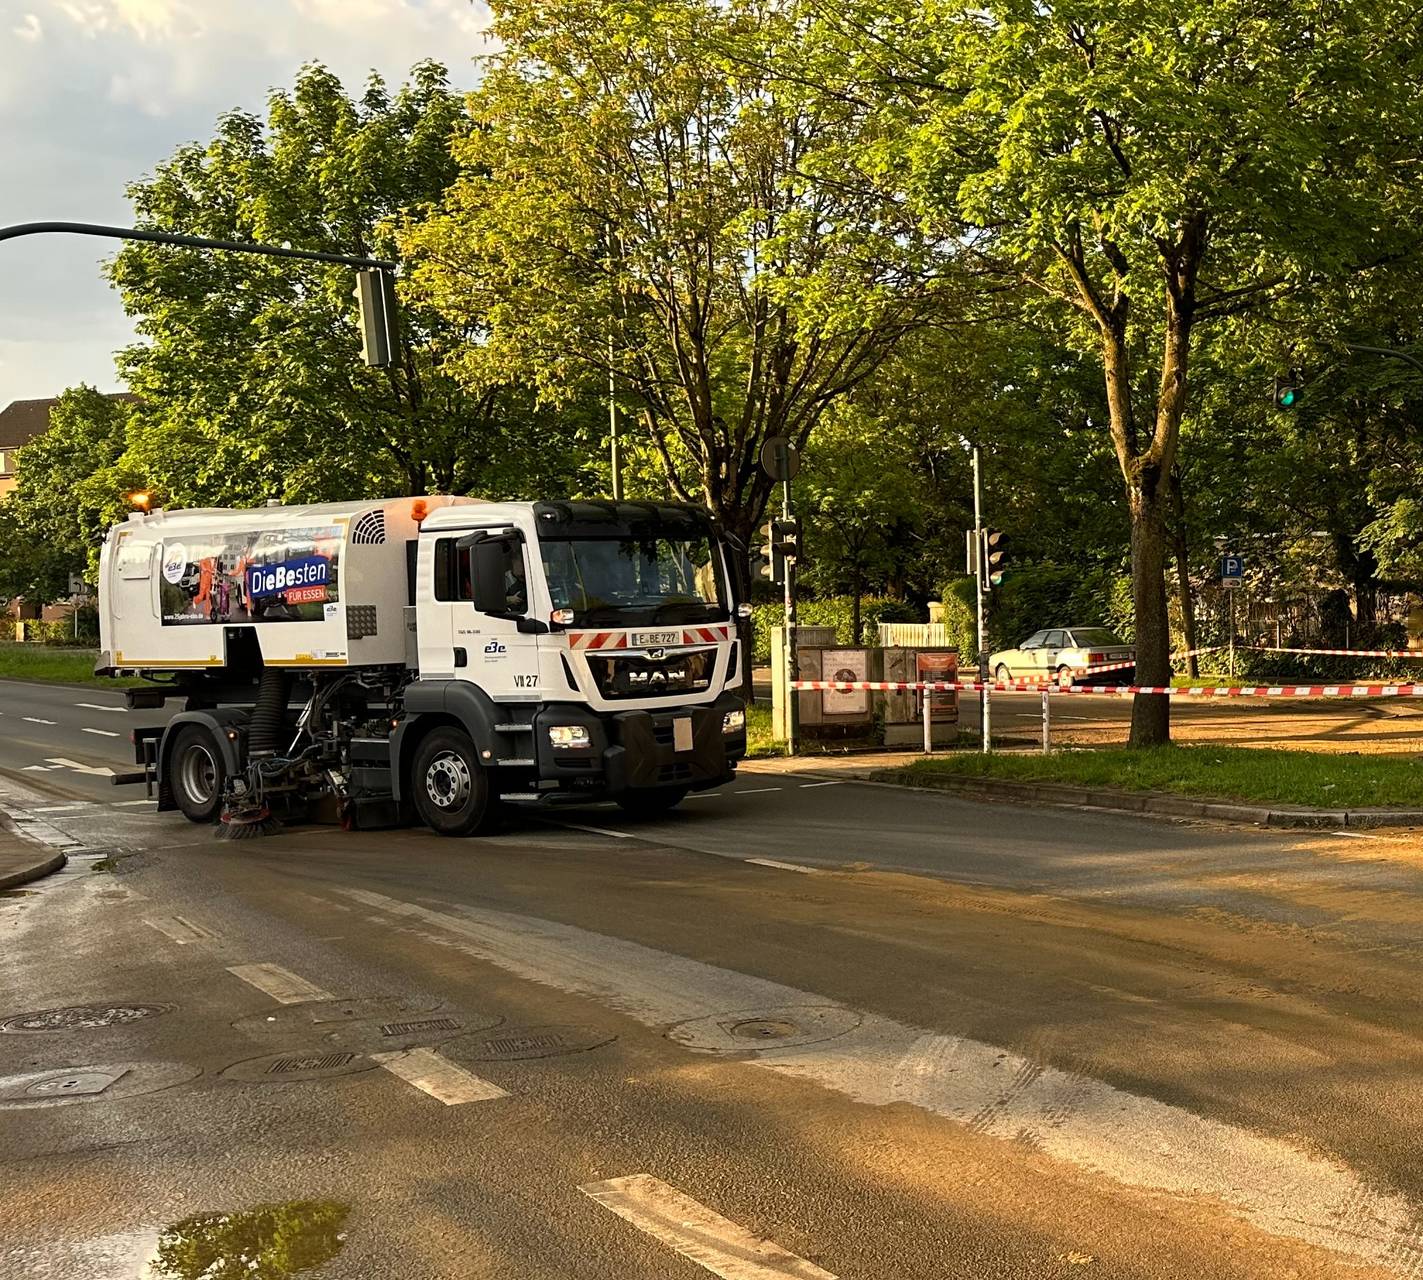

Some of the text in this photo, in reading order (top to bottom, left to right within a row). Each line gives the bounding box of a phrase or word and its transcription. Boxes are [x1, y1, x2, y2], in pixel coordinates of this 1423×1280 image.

[1226, 559, 1239, 575] P
[252, 562, 326, 594] DieBesten
[302, 588, 324, 600] ESSEN
[661, 633, 676, 643] 727
[526, 675, 538, 688] 27
[629, 669, 686, 686] MAN
